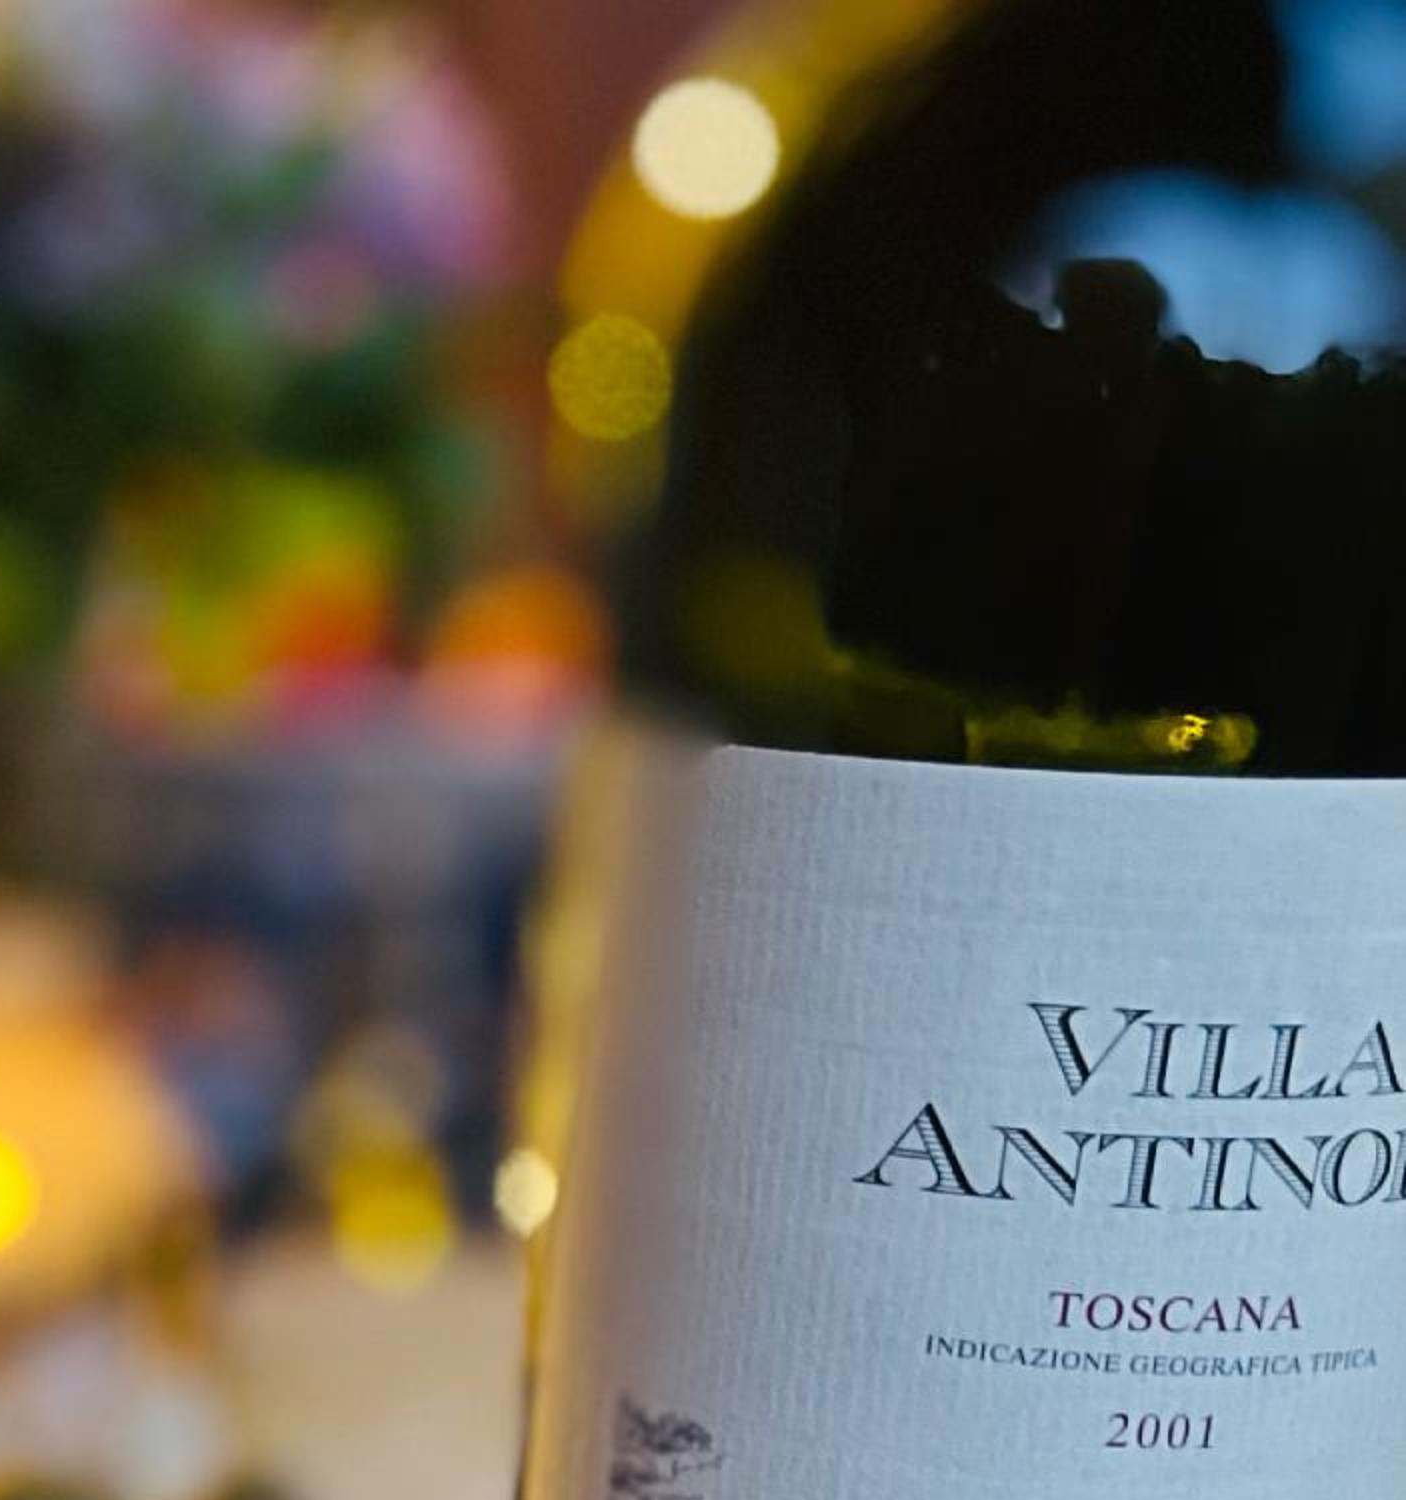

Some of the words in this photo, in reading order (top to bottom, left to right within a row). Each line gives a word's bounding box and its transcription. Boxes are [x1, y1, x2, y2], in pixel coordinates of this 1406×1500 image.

[1027, 1003, 1406, 1098] VILLA
[1050, 1291, 1301, 1333] TOSCANA
[926, 1334, 1122, 1374] INDICAZIONE
[1129, 1353, 1301, 1377] GEOGRAFICA
[1310, 1347, 1378, 1374] TIPICA
[1105, 1413, 1216, 1449] 2001
